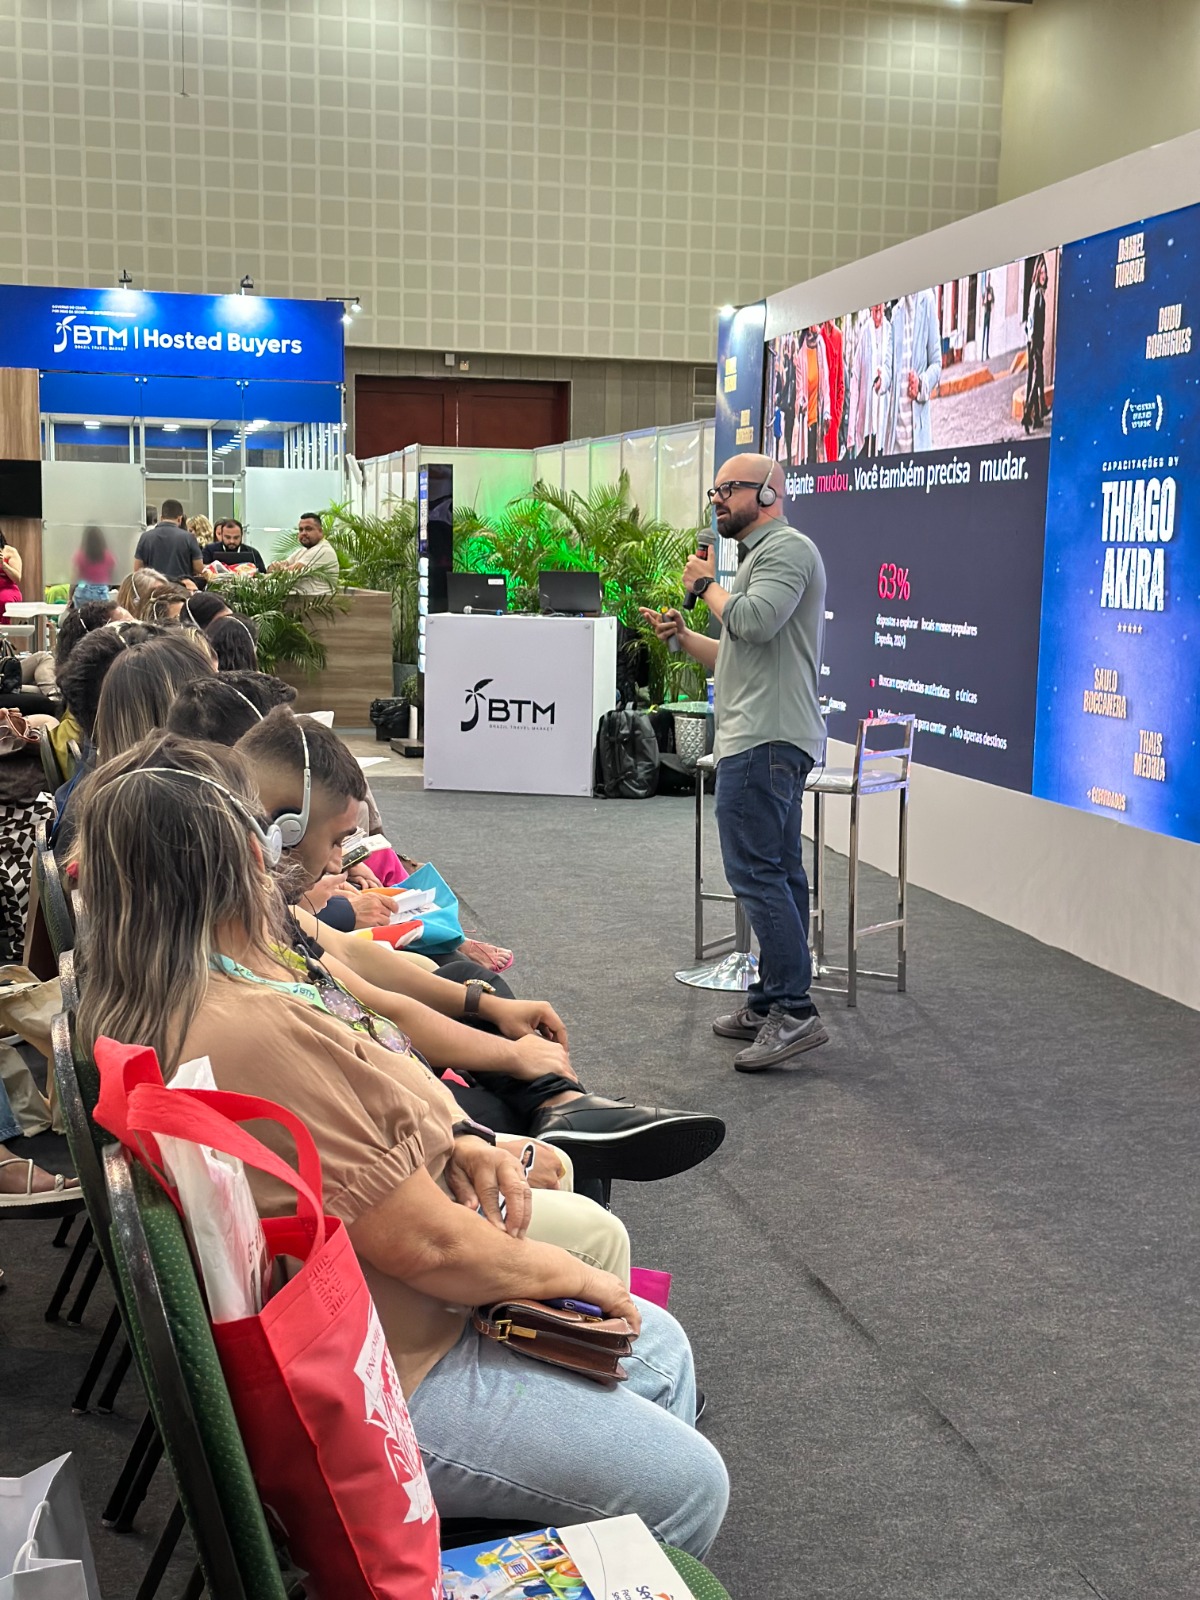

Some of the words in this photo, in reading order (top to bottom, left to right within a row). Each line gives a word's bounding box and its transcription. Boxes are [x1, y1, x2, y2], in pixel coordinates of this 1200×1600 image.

[1158, 303, 1182, 332] DUDU
[73, 325, 128, 347] BTM
[143, 328, 222, 351] Hosted
[227, 332, 303, 358] Buyers
[1145, 327, 1192, 360] RODRIGUES
[854, 463, 878, 491] Você
[879, 459, 925, 489] também
[926, 456, 971, 494] precisa
[979, 450, 1029, 483] mudar.
[1167, 456, 1180, 467] BY
[1101, 476, 1177, 542] THIAGO
[877, 563, 911, 600] 63%
[1100, 547, 1165, 612] AKIRA
[1093, 668, 1118, 693] SAULO
[488, 698, 556, 725] BTM
[963, 729, 983, 744] apenas
[1133, 752, 1166, 782] MEDINA
